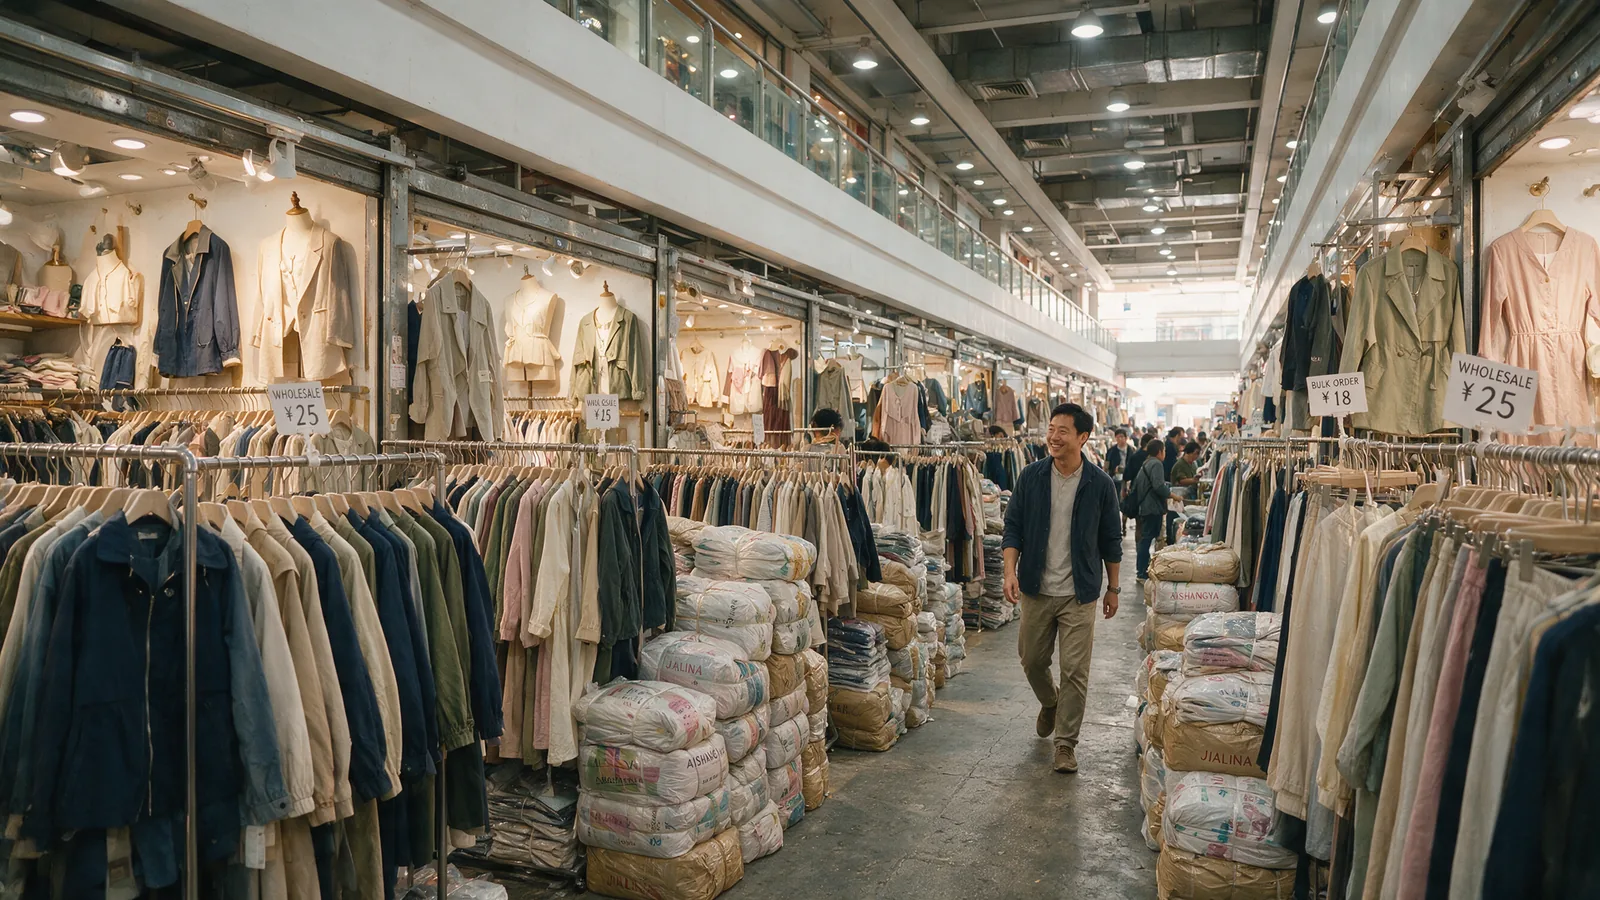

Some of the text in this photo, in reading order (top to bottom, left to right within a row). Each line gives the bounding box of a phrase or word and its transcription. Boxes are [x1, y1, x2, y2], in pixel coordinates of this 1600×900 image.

[1458, 360, 1534, 390] WHOLESALE
[1311, 376, 1359, 390] BULK ORDER
[272, 387, 321, 400] WHOLESALE
[1170, 591, 1219, 601] AISHANGYA
[1200, 750, 1253, 767] JIALINA
